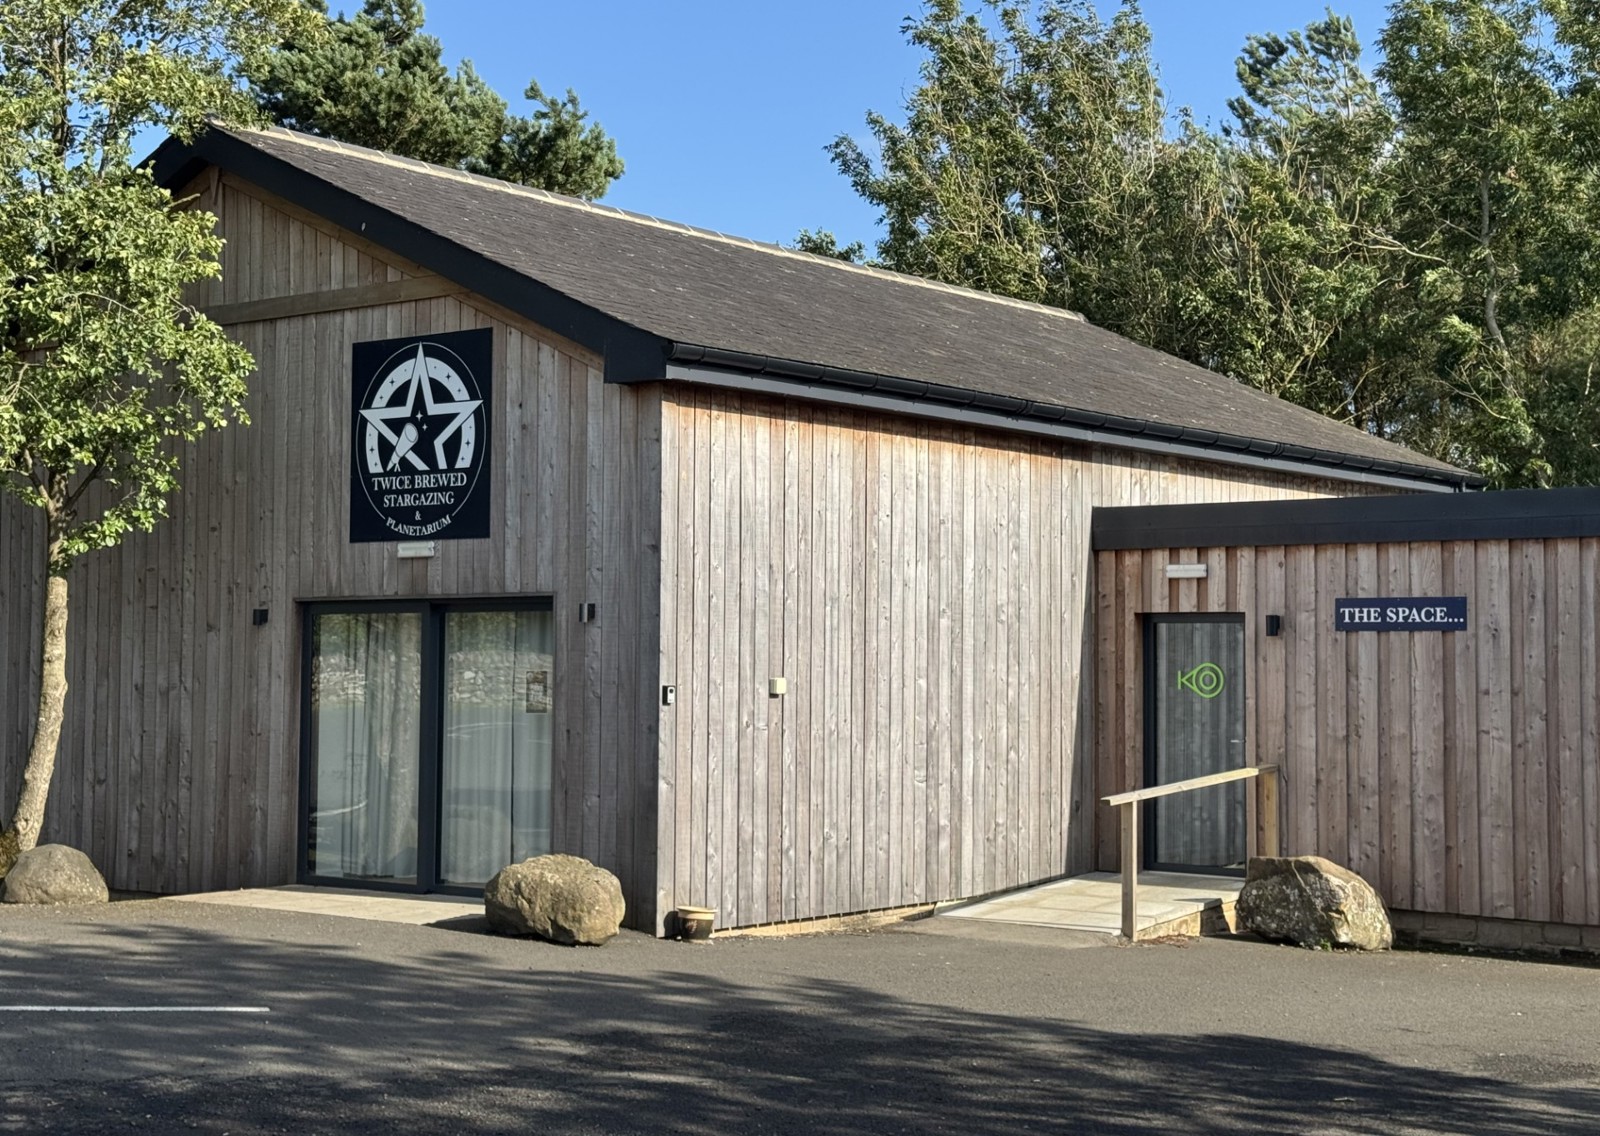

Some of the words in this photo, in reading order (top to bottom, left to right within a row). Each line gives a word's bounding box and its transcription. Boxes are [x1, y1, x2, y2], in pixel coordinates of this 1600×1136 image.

[372, 475, 412, 491] TWICE
[414, 472, 467, 489] BREWED
[383, 491, 455, 508] STARGAZING
[415, 510, 421, 521] &
[386, 514, 451, 536] PLANETARIUM
[1340, 607, 1381, 623] THE
[1386, 607, 1464, 623] SPACE...
